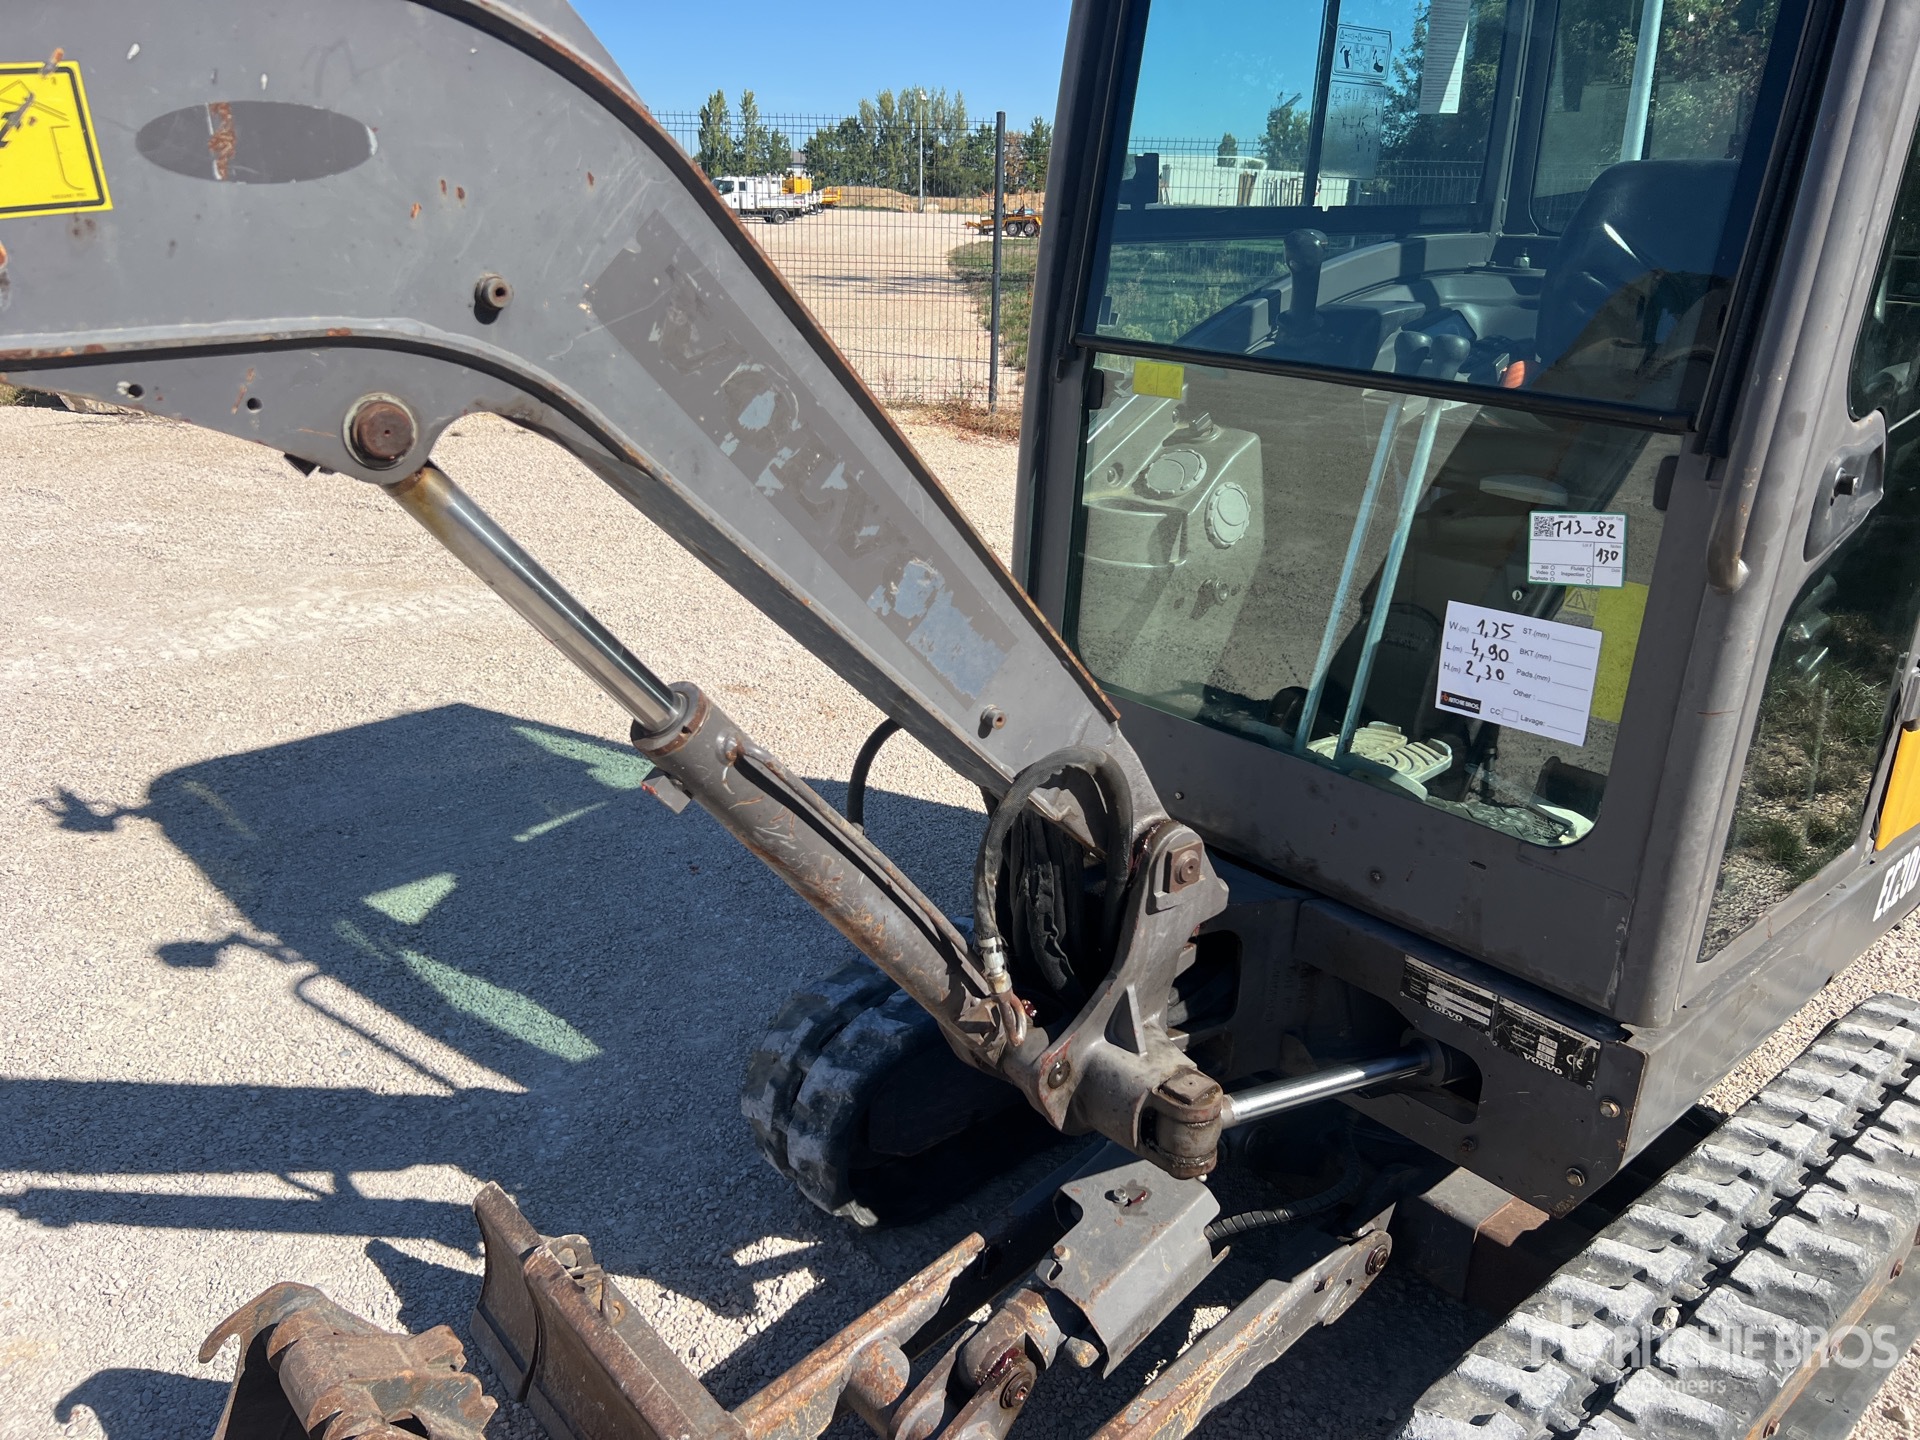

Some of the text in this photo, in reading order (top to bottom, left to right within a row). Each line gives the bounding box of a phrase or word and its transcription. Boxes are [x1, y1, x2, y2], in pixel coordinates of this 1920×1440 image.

[1596, 548, 1619, 565] 130
[1872, 846, 1920, 922] EC20
[1425, 1000, 1463, 1022] VOLVO
[1522, 1051, 1563, 1075] VOLVO
